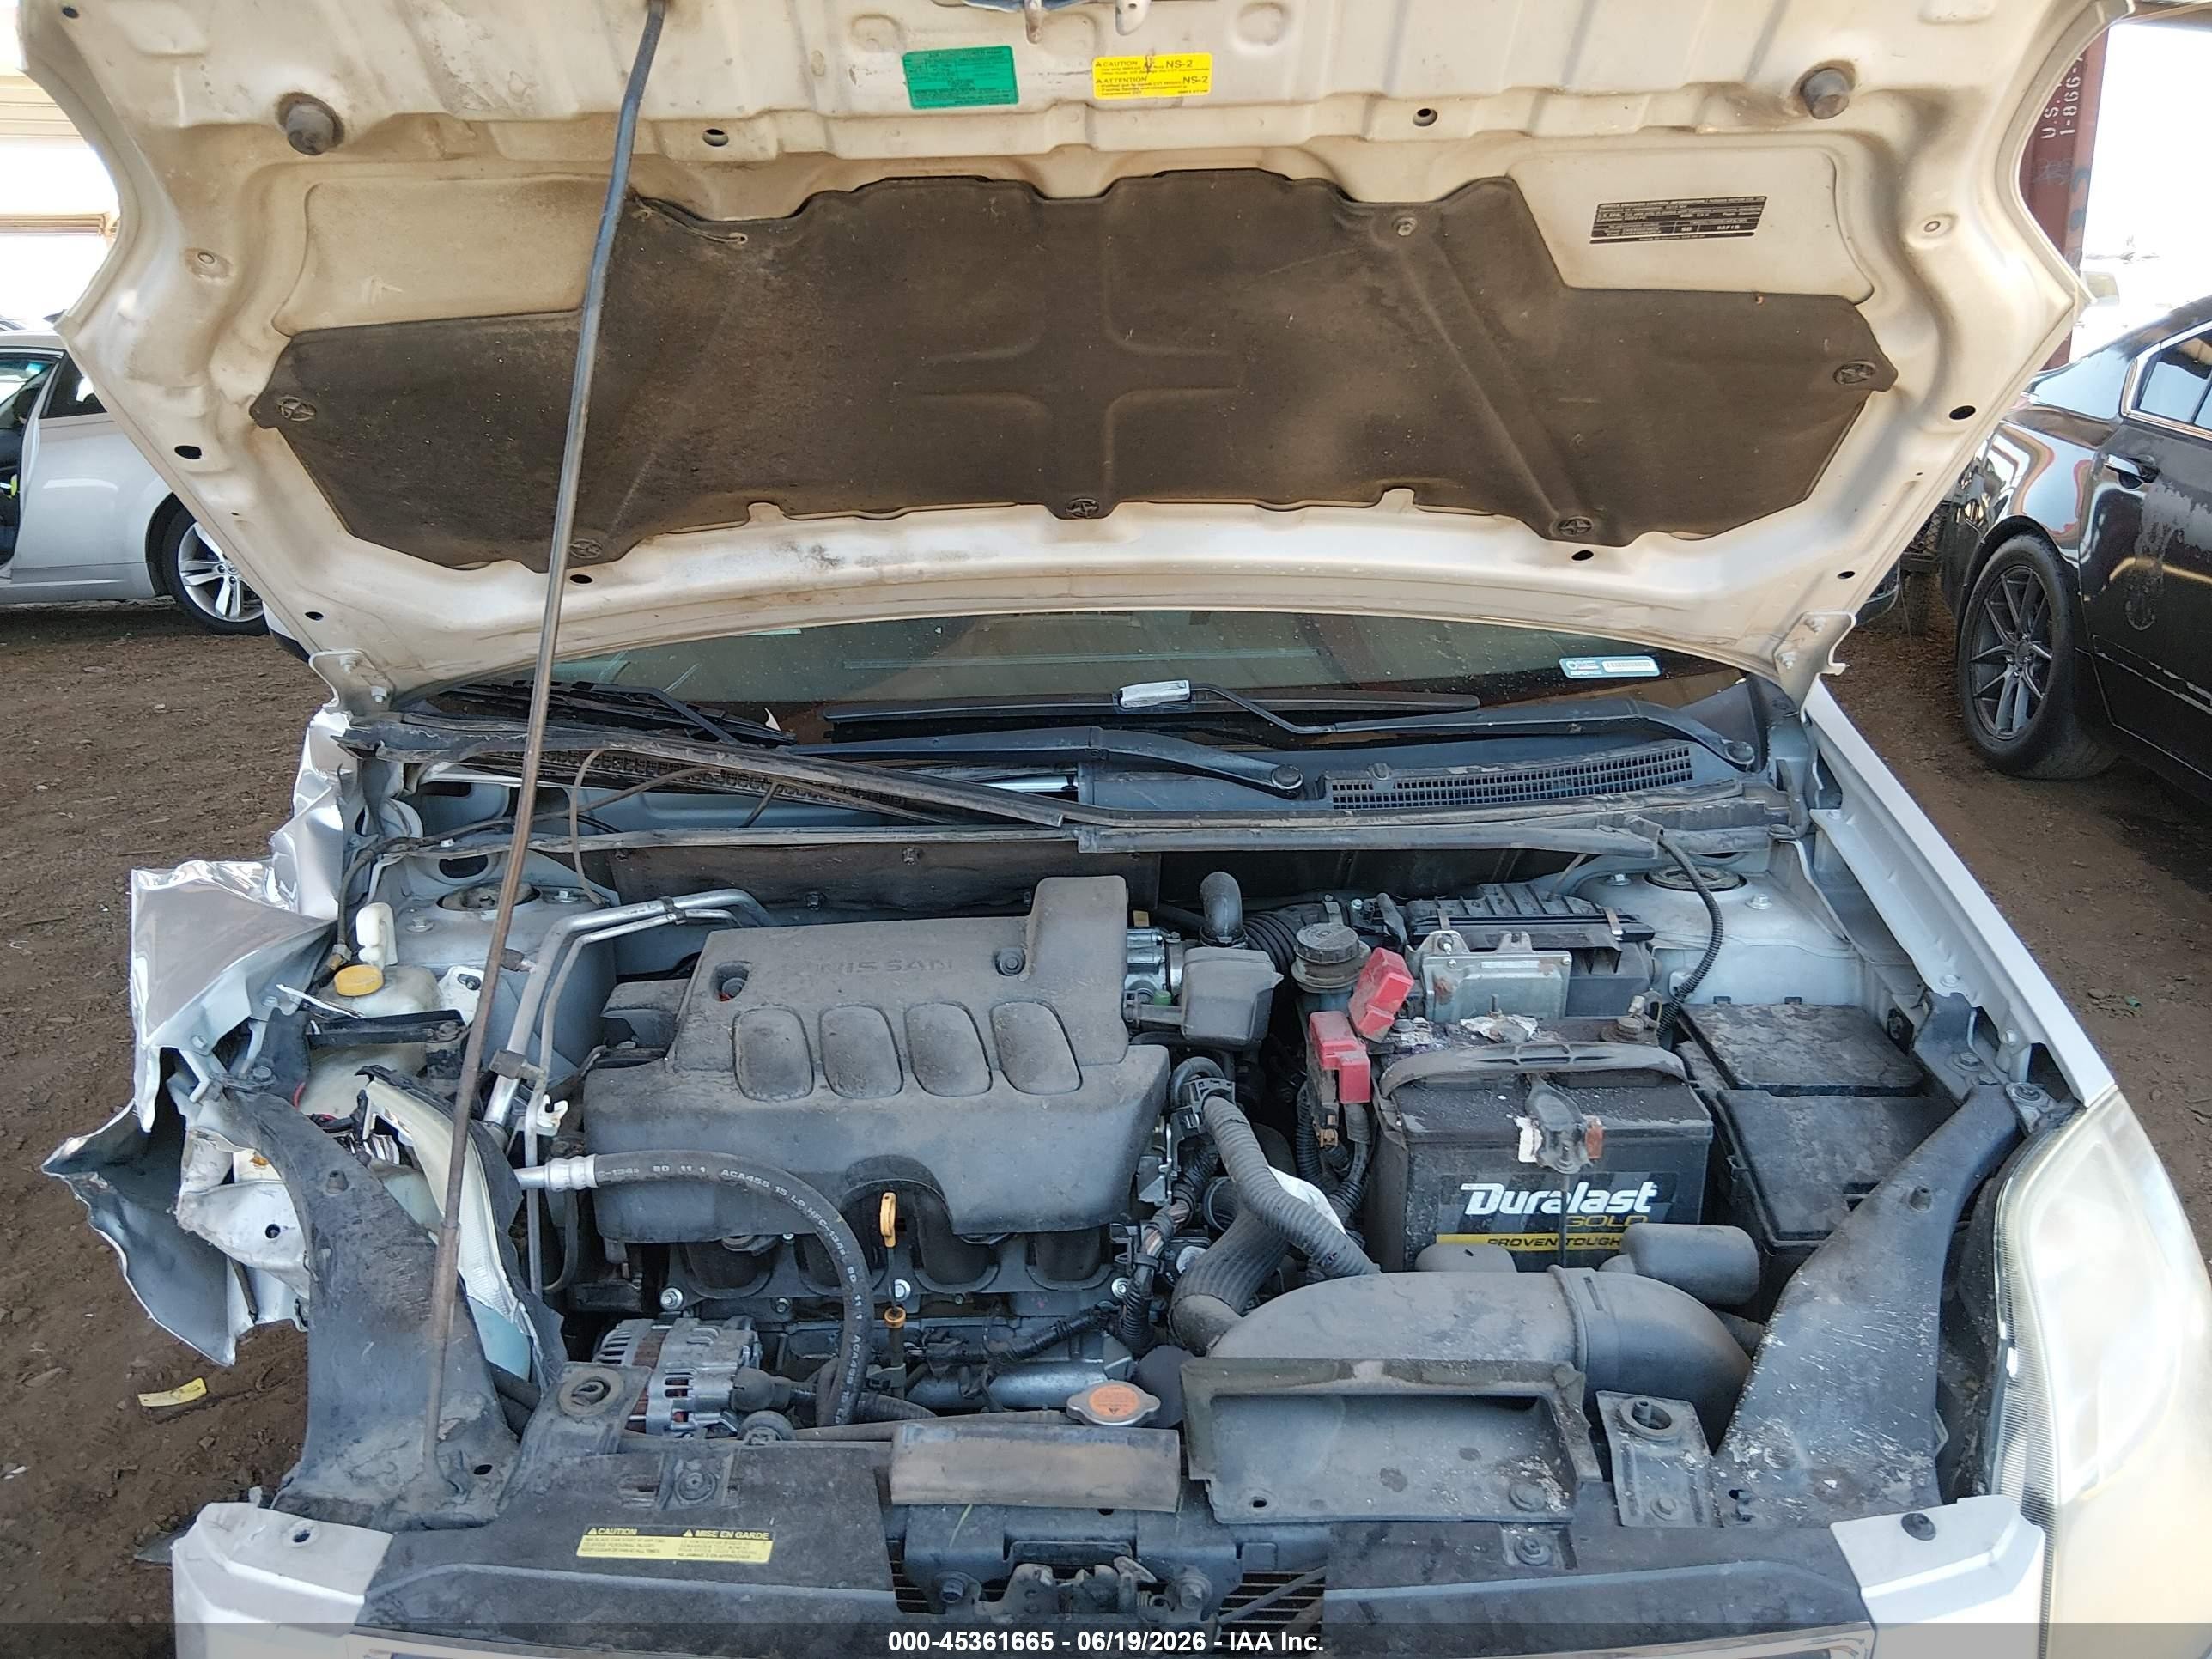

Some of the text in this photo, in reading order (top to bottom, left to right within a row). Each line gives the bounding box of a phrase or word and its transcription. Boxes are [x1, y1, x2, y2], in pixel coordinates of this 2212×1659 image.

[1165, 59, 1193, 69] NS-2
[1182, 76, 1208, 84] NS-2
[2059, 57, 2082, 136] 1-866-
[1461, 1182, 1658, 1215] Duralast
[1487, 1237, 1621, 1247] PROVEN TOUGH
[695, 1529, 720, 1538] MISE
[734, 1531, 770, 1540] GARDE
